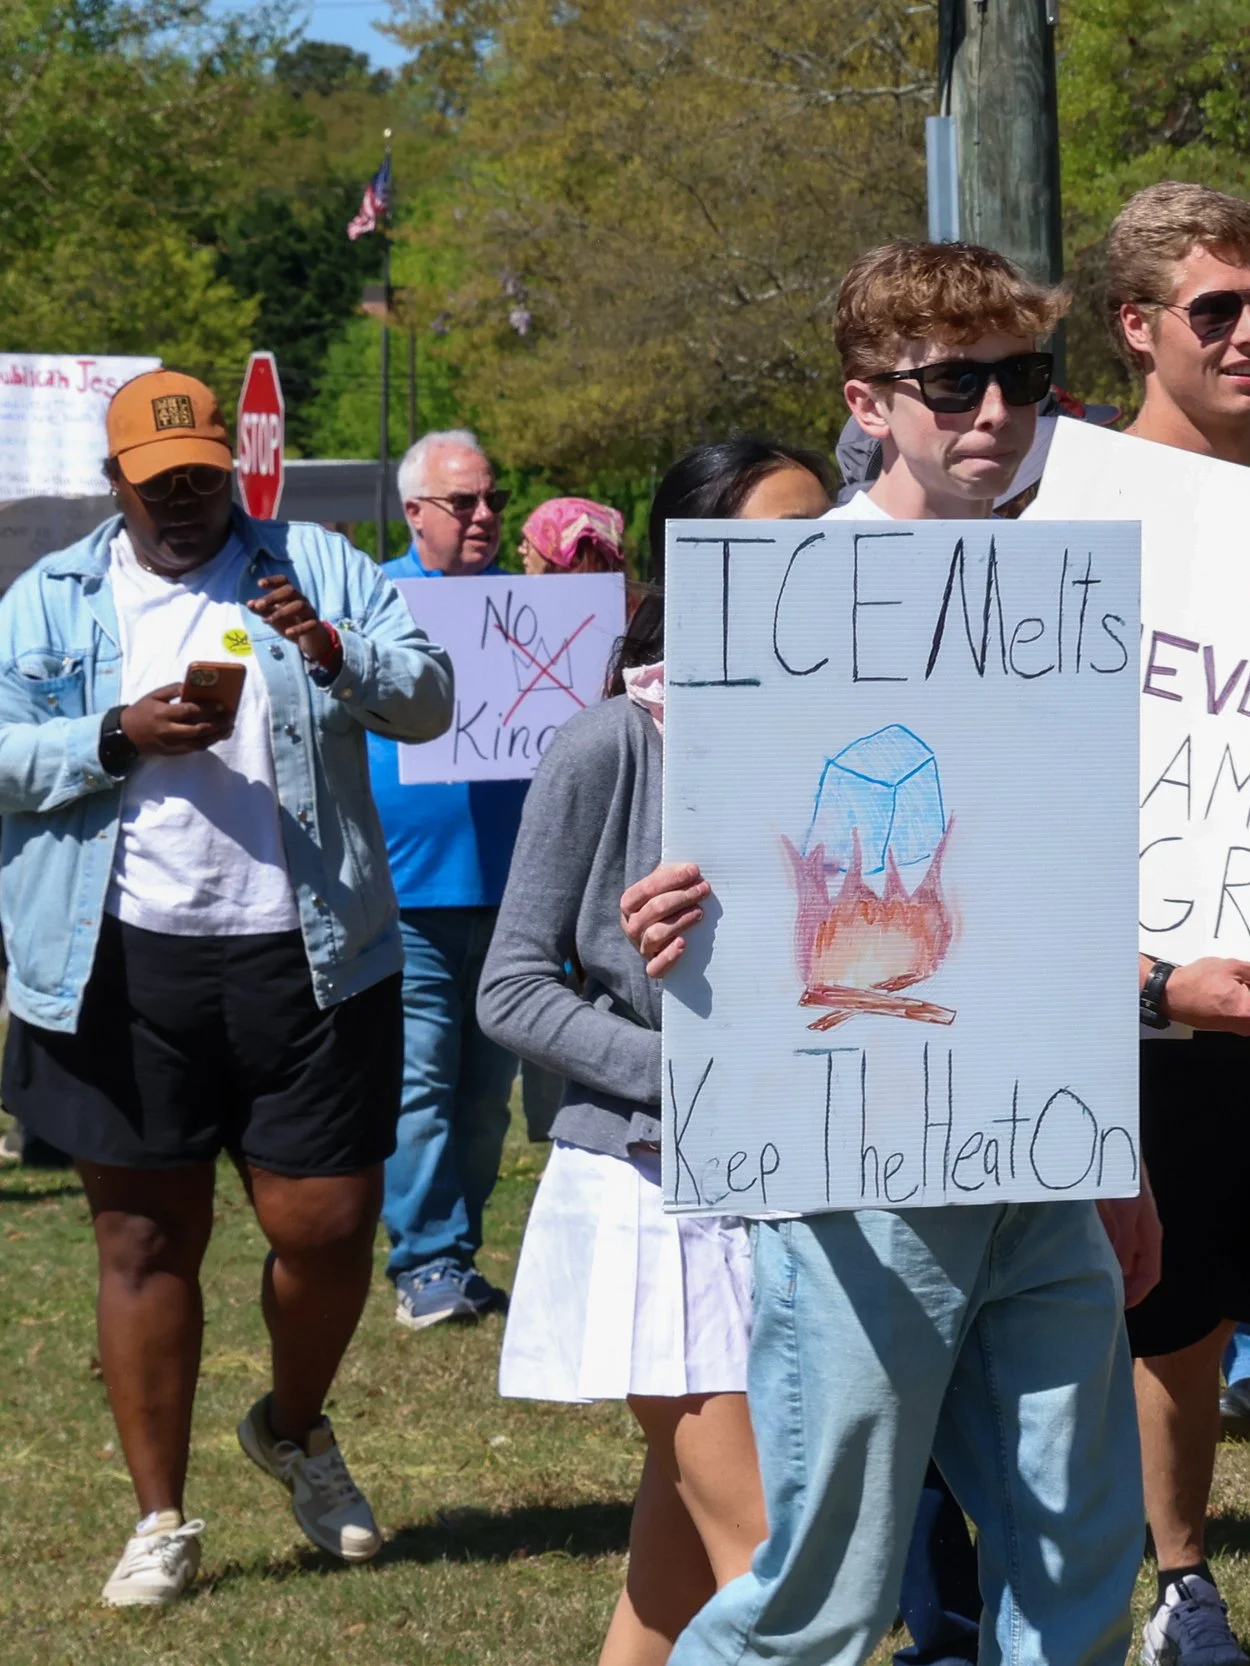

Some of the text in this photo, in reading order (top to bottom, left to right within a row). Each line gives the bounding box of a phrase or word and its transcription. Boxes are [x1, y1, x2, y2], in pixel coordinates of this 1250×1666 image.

[76, 361, 125, 399] Jes
[241, 412, 280, 476] STOP
[669, 532, 1128, 687] ICE Melts
[668, 1041, 1136, 1206] Keep The Heat On
